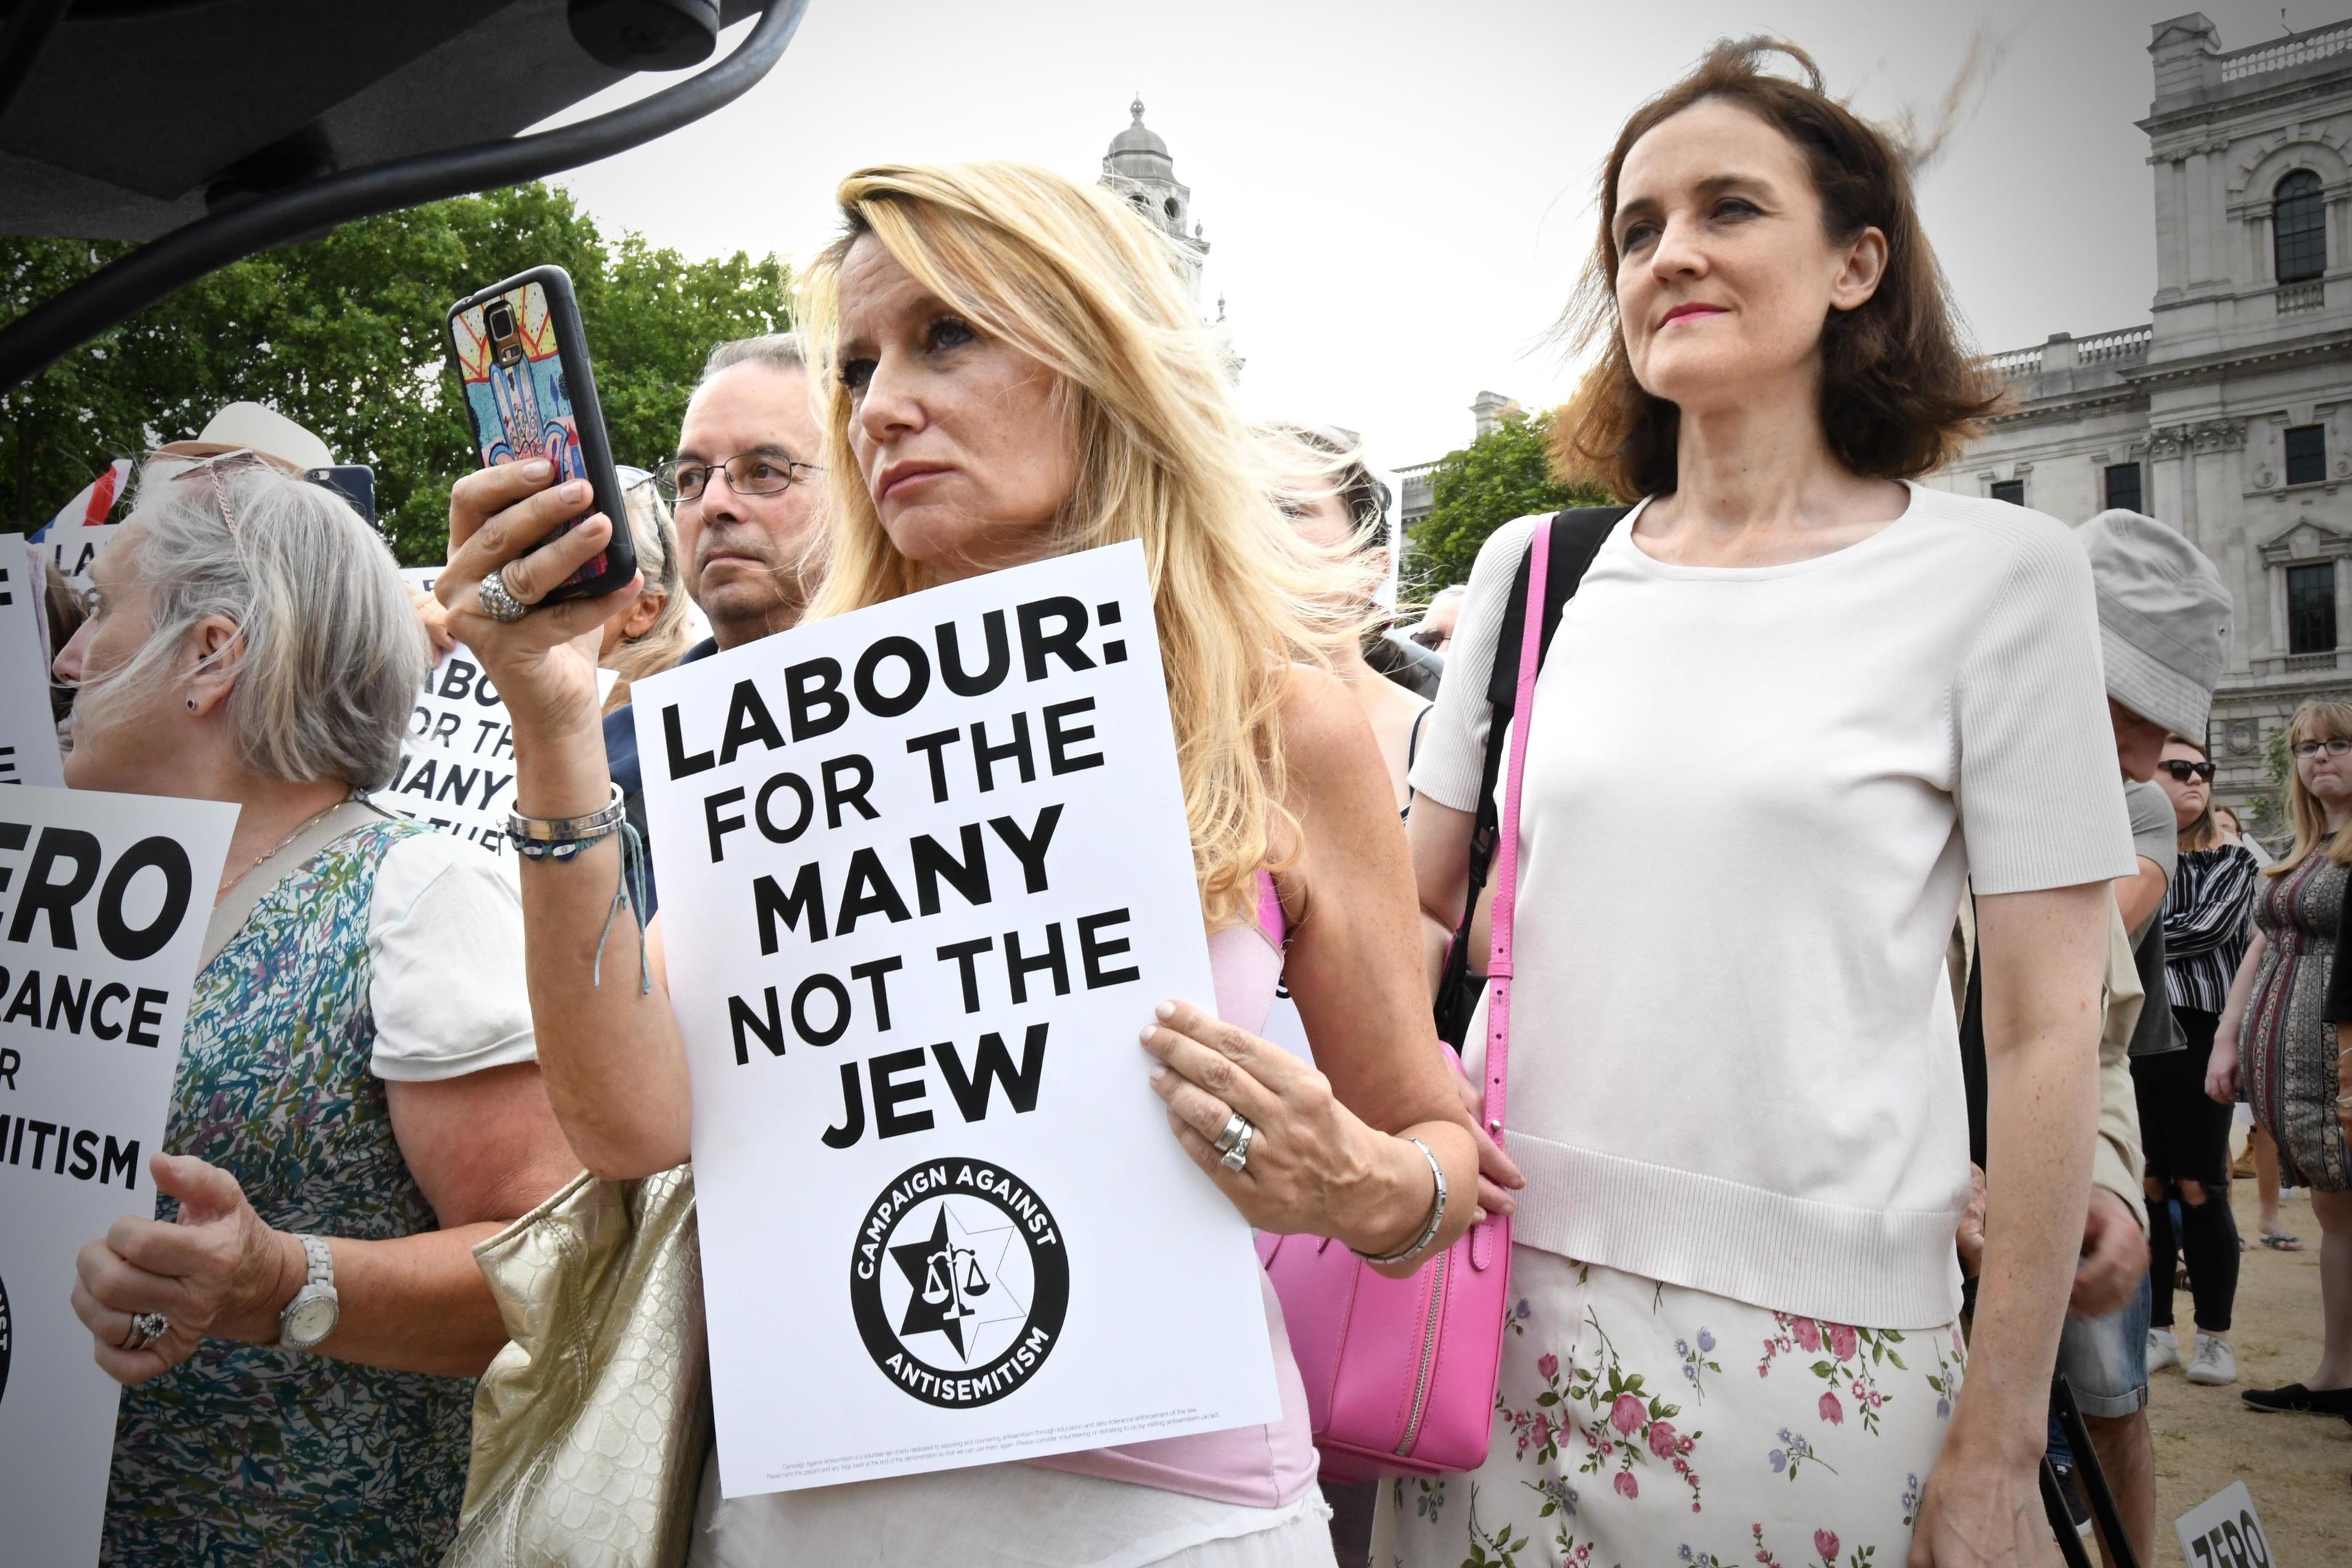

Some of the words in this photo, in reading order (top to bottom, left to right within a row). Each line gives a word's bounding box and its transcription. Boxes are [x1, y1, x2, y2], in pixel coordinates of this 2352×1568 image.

[663, 596, 1128, 781] LABOUR:
[704, 754, 881, 864] FOR
[907, 696, 1105, 804] THE
[753, 803, 1065, 956] MANY
[728, 955, 903, 1066] NOT
[936, 907, 1140, 1014] THE
[821, 1022, 1050, 1149] JEW
[857, 1165, 947, 1280] CAMPAIGN
[955, 1165, 1057, 1246] AGAINST
[885, 1326, 1050, 1401] ANTISEMITISM
